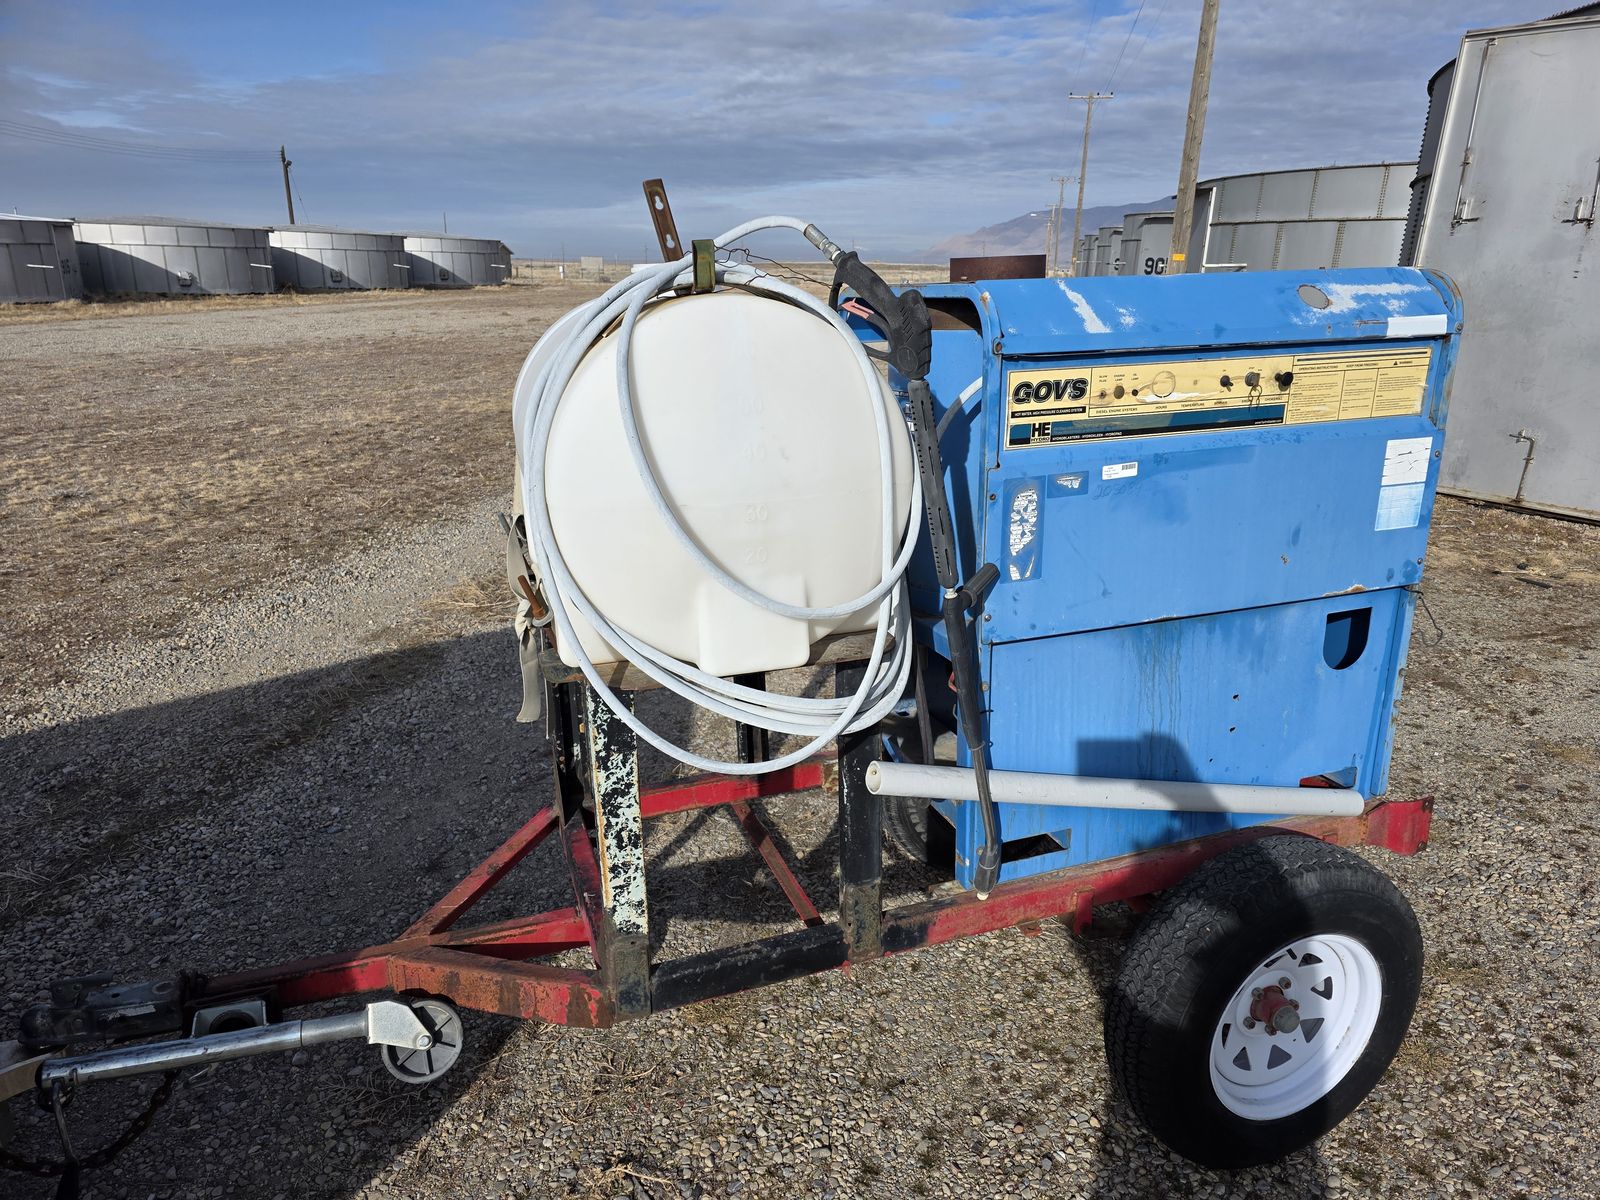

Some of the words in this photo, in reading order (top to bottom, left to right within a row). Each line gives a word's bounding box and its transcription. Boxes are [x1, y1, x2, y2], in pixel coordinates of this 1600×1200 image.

[1012, 378, 1088, 404] GOVS
[744, 503, 769, 523] 30
[744, 545, 769, 566] 20
